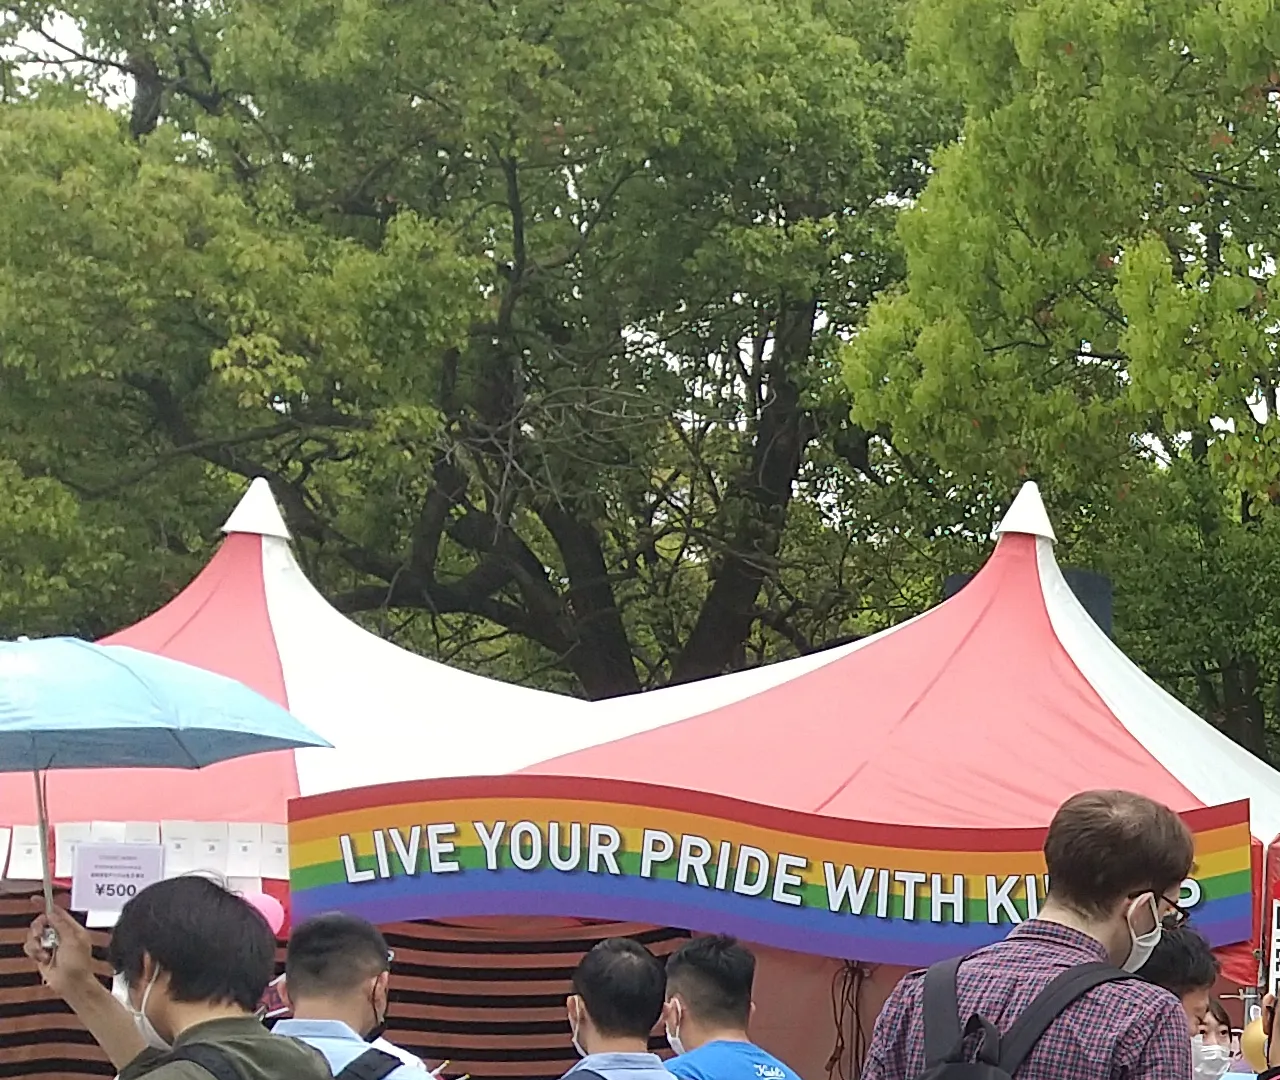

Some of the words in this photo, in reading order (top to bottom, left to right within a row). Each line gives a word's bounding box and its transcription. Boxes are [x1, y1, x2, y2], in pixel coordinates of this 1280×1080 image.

[95, 883, 137, 897] ¥500
[339, 822, 461, 883] LIVE
[472, 820, 621, 875] YOUR
[639, 828, 808, 907] PRIDE
[822, 861, 966, 925] WITH
